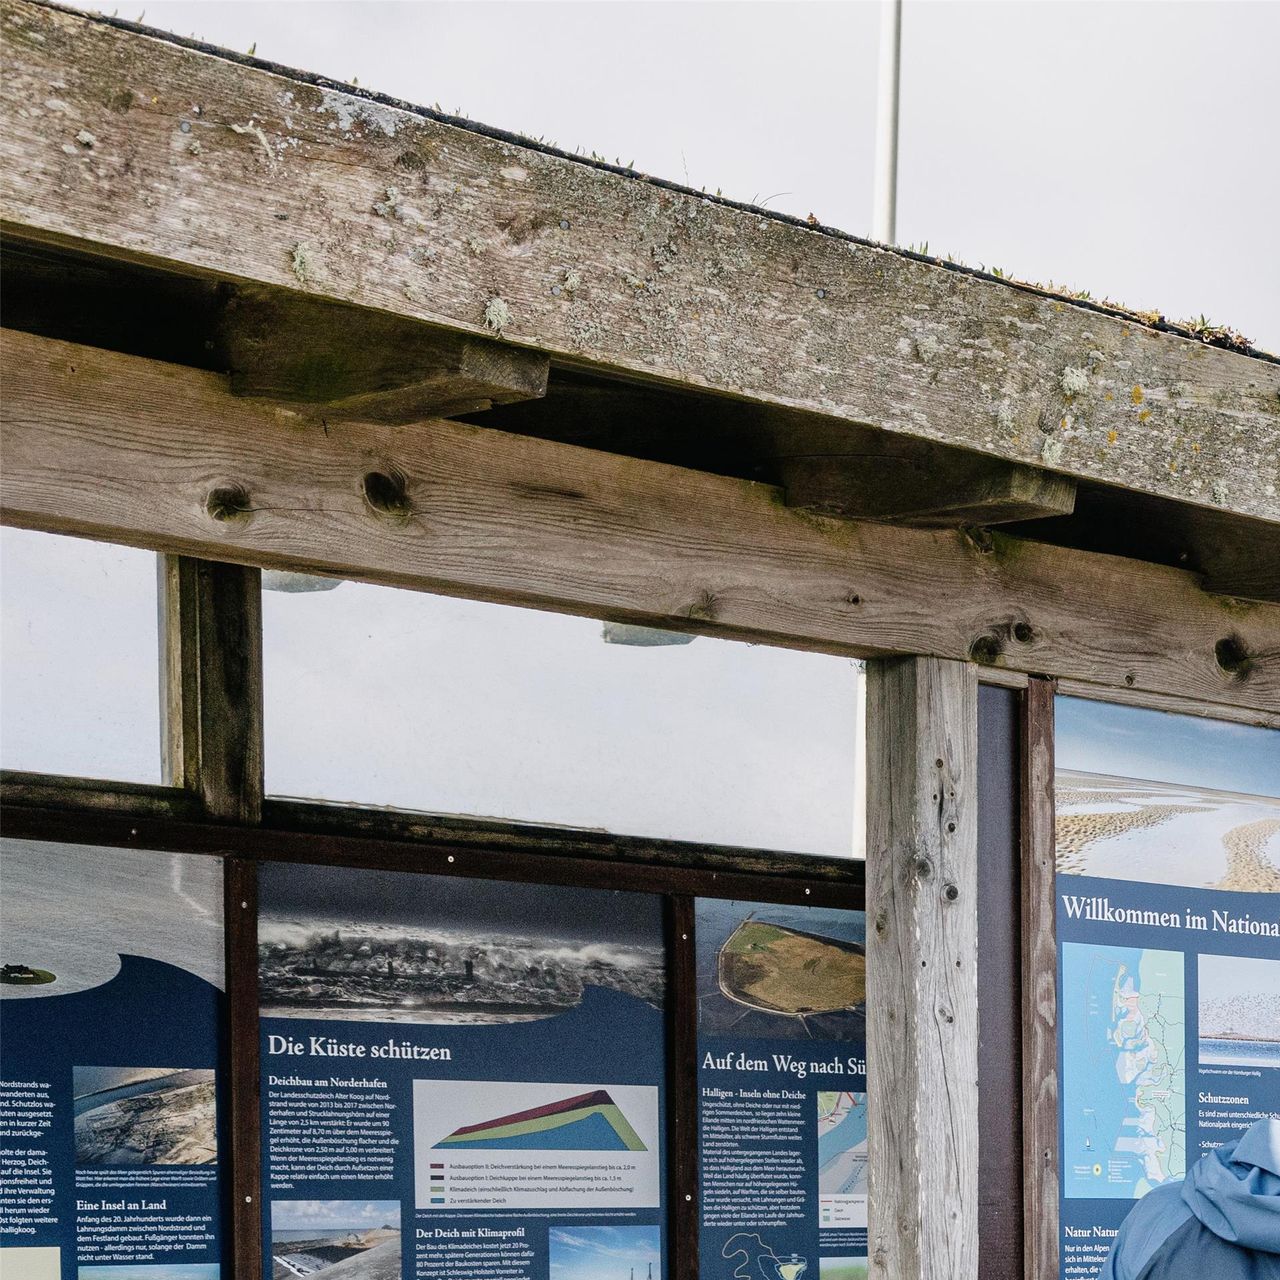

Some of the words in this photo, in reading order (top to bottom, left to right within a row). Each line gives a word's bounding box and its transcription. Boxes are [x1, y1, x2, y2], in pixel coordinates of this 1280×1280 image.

[1062, 896, 1180, 928] Willkommen
[1186, 907, 1207, 931] im
[268, 1035, 304, 1055] Die
[310, 1036, 366, 1057] Küste
[371, 1039, 452, 1060] schützen
[702, 1052, 734, 1070] Auf
[736, 1053, 769, 1071] dem
[772, 1054, 806, 1078] Weg
[810, 1056, 843, 1074] nach
[848, 1057, 866, 1074] Sü
[268, 1075, 312, 1086] Deichbau
[330, 1077, 388, 1088] Norderhafen
[349, 1092, 364, 1101] Koog
[702, 1088, 733, 1100] Halligen
[740, 1088, 761, 1098] Inseln
[762, 1089, 780, 1098] ohne
[782, 1089, 806, 1099] Deiche
[1199, 1092, 1249, 1104] Schutzzonen
[1, 1158, 27, 1167] Herzog,
[299, 1155, 359, 1164] Meeresspiegelanstieg
[367, 1155, 393, 1164] notwenig
[77, 1200, 99, 1210] Eine
[102, 1200, 125, 1210] Insel
[142, 1200, 167, 1209] Land
[76, 1215, 100, 1224] Anfang
[416, 1228, 433, 1238] Der
[435, 1228, 460, 1237] Deich
[461, 1228, 476, 1237] mit
[478, 1227, 525, 1240] Klimaprofil
[1064, 1226, 1091, 1237] Natur
[1093, 1226, 1119, 1237] Natur
[120, 1234, 143, 1243] gebaut.
[145, 1234, 178, 1243] Fußgänger
[1094, 1244, 1110, 1253] Alpen
